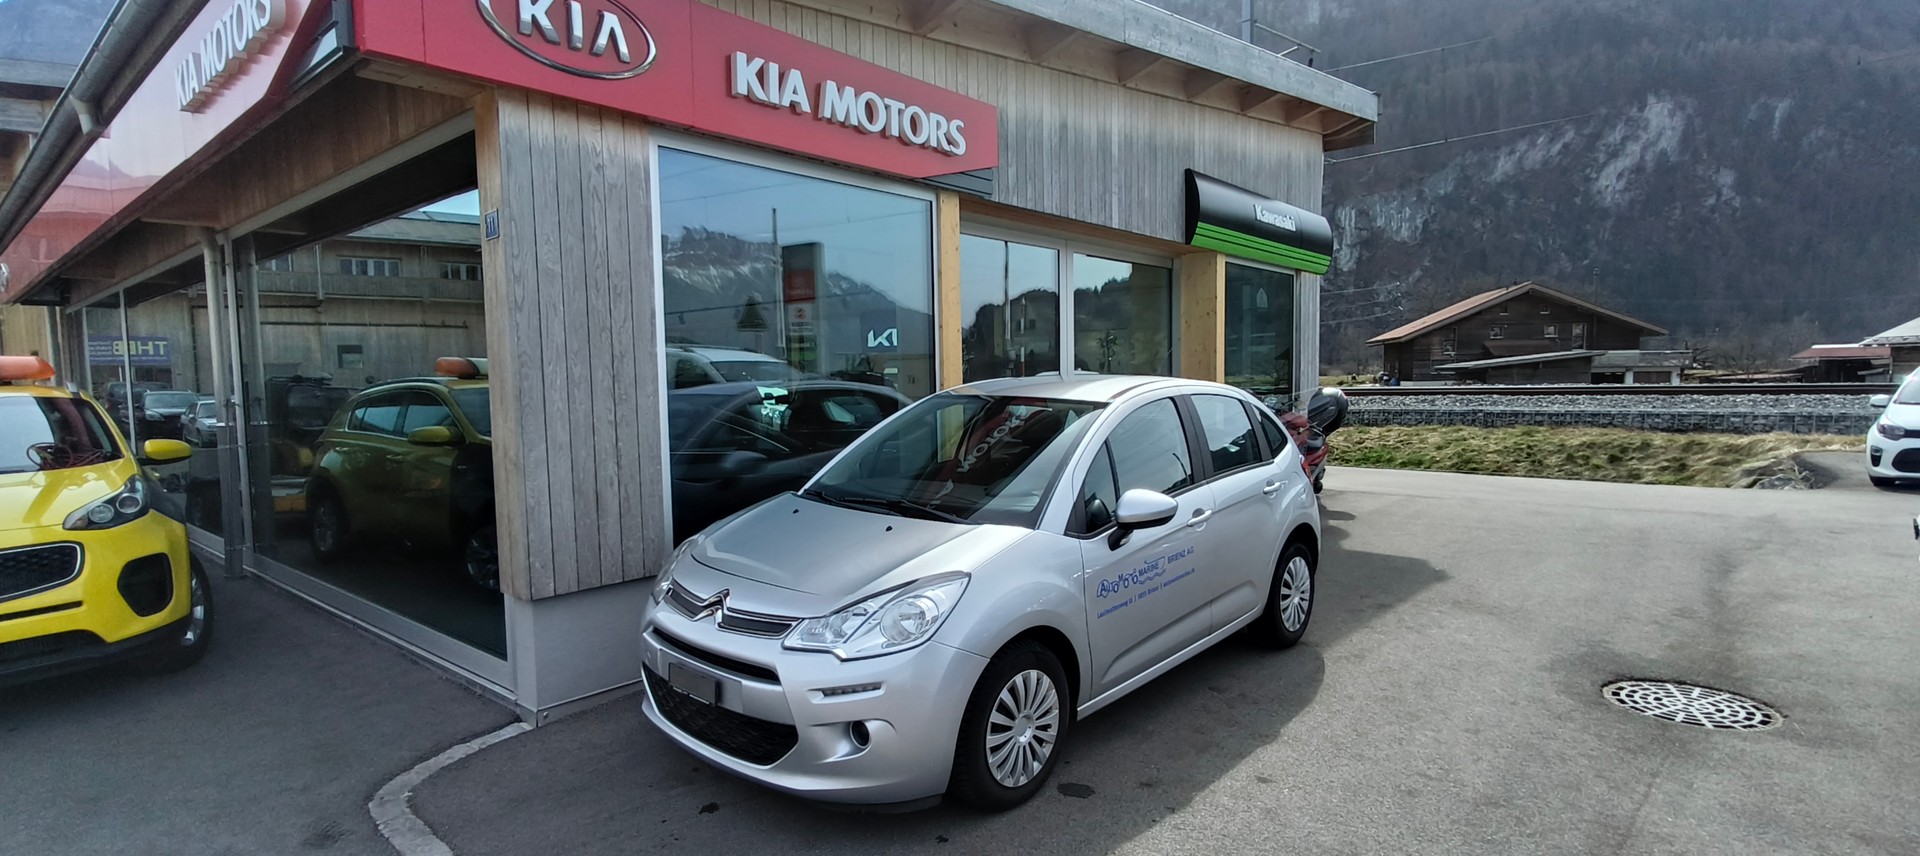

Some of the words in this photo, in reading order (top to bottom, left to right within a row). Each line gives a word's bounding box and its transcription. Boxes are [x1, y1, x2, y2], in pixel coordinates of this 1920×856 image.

[515, 0, 631, 63] KIA
[175, 51, 200, 111] KIA
[729, 50, 812, 114] KIA
[817, 79, 967, 156] MOTORS
